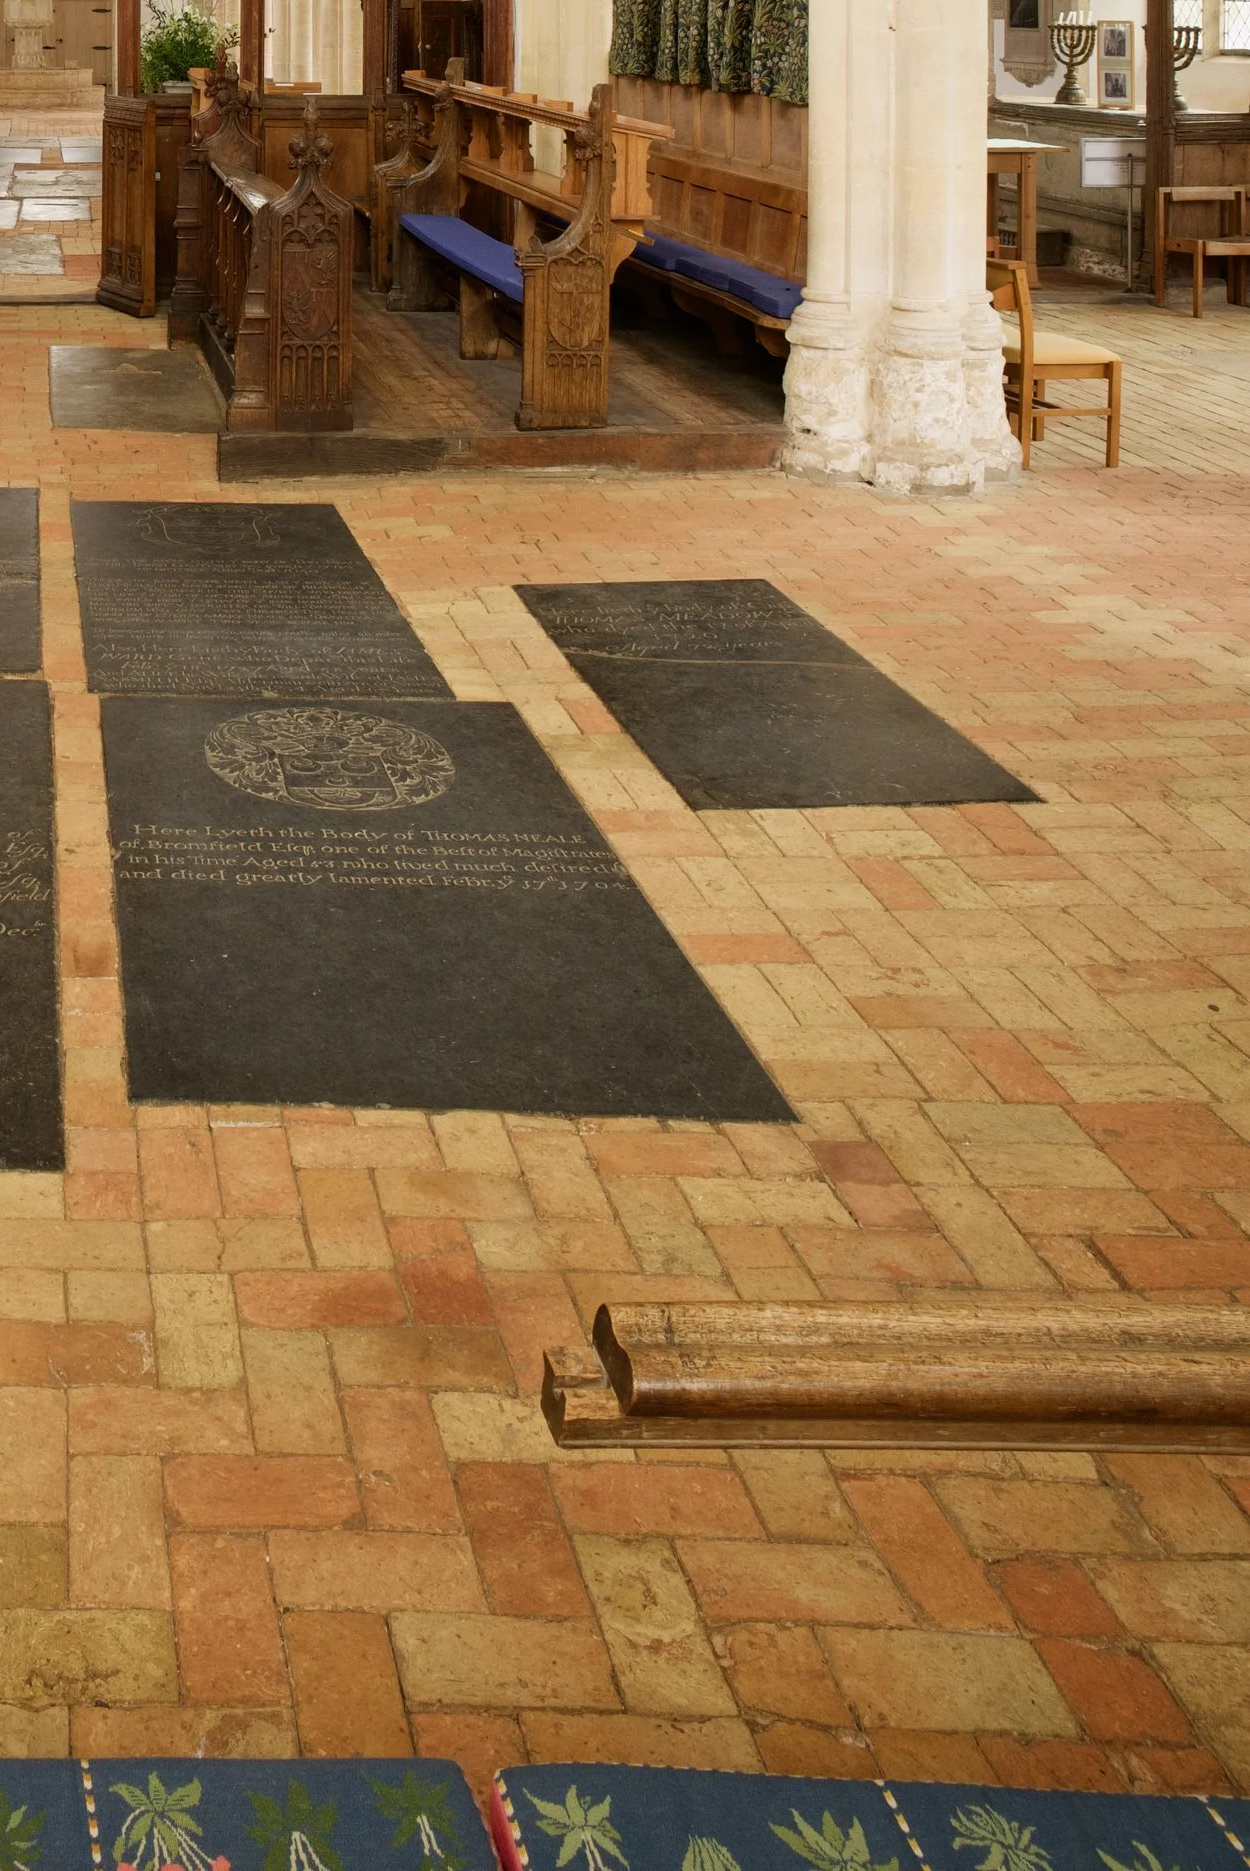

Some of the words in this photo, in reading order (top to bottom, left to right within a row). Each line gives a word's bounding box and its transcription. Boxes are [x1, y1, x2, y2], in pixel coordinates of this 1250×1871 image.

[7, 828, 41, 841] of
[132, 824, 198, 836] Here
[203, 826, 275, 839] Lyeth
[278, 827, 315, 838] the
[320, 828, 388, 842] Body
[394, 829, 415, 841] of
[420, 830, 510, 842] THOMAS
[512, 833, 587, 844] NEALE
[146, 839, 263, 852] Bromfield
[320, 846, 360, 854] one
[367, 844, 389, 855] of
[394, 845, 434, 855] the
[478, 847, 499, 857] of
[128, 856, 149, 864] in
[154, 856, 186, 865] his
[188, 855, 237, 866] Time
[242, 856, 305, 870] Aged
[341, 858, 389, 869] who
[394, 860, 449, 871] lived
[454, 861, 518, 872] much
[119, 869, 163, 879] and
[171, 869, 227, 881] died
[235, 873, 324, 886] greatly
[327, 873, 435, 886] lamented
